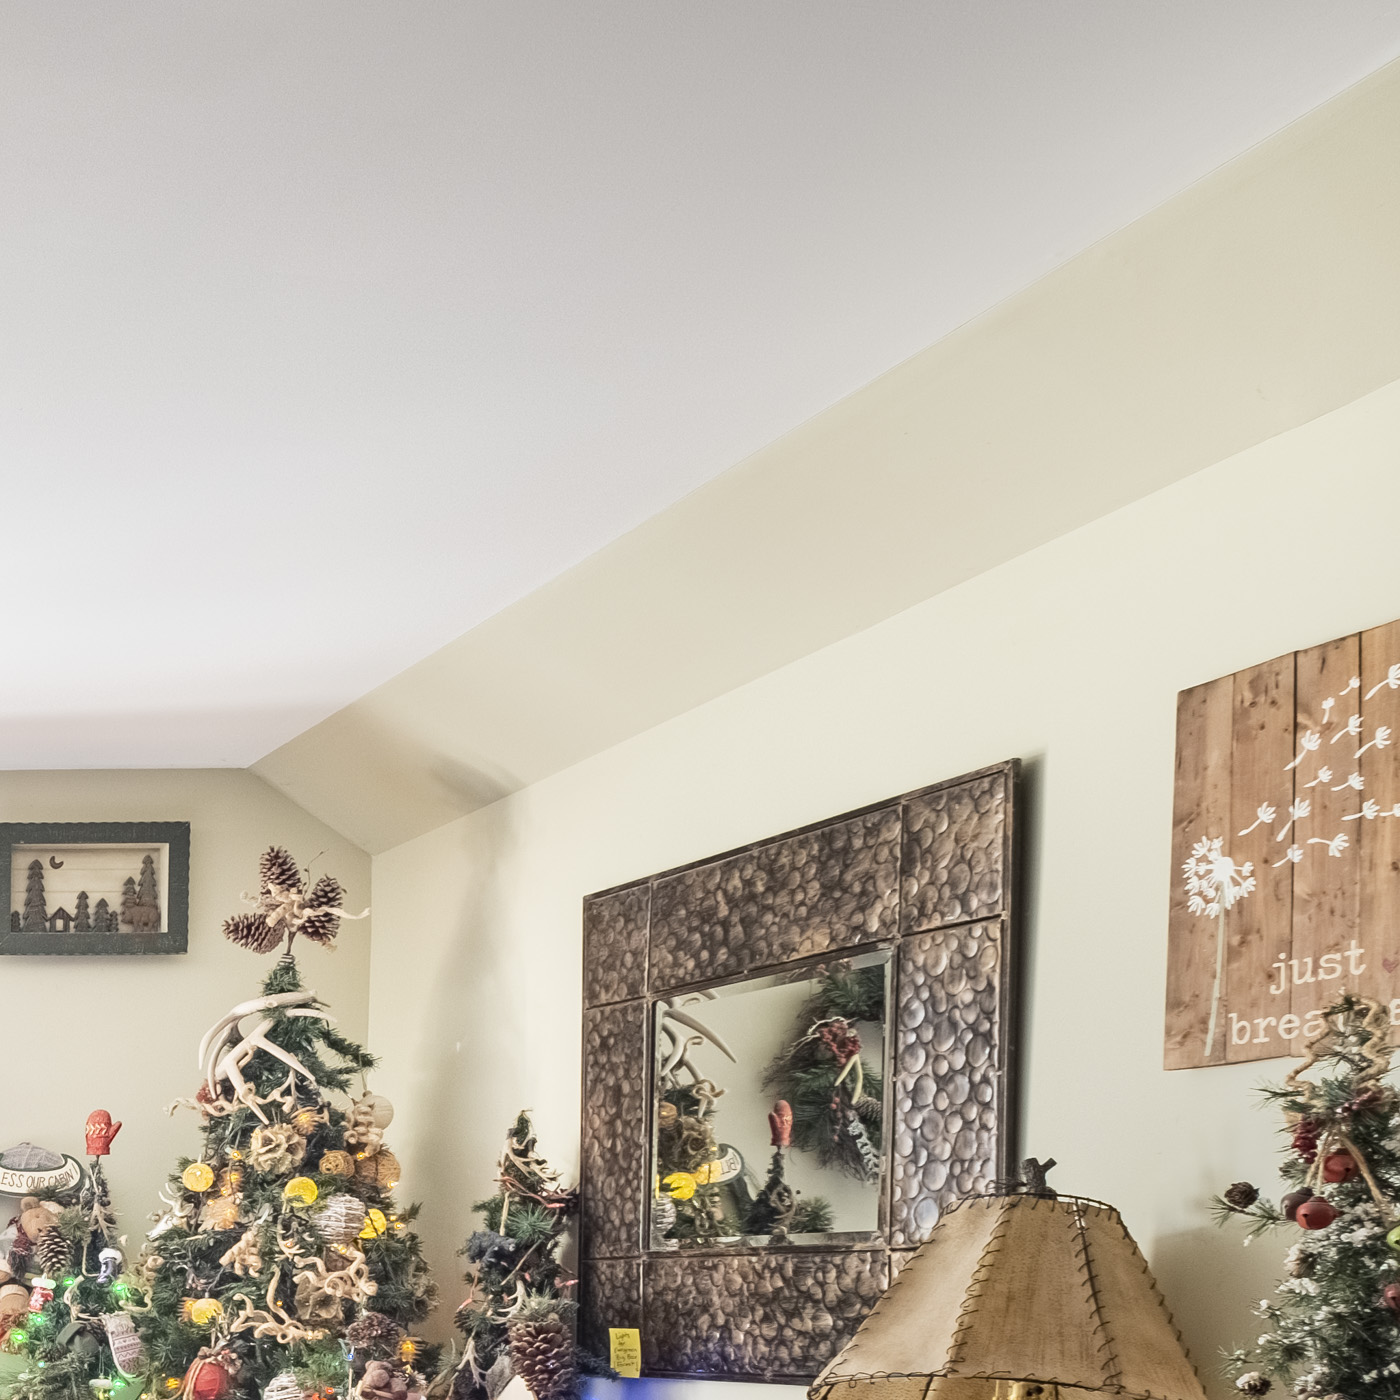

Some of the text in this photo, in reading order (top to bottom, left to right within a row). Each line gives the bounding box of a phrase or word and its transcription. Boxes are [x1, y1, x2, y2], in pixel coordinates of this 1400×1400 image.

[1269, 940, 1367, 994] just
[26, 1175, 47, 1189] OUR
[48, 1168, 75, 1187] CABIN
